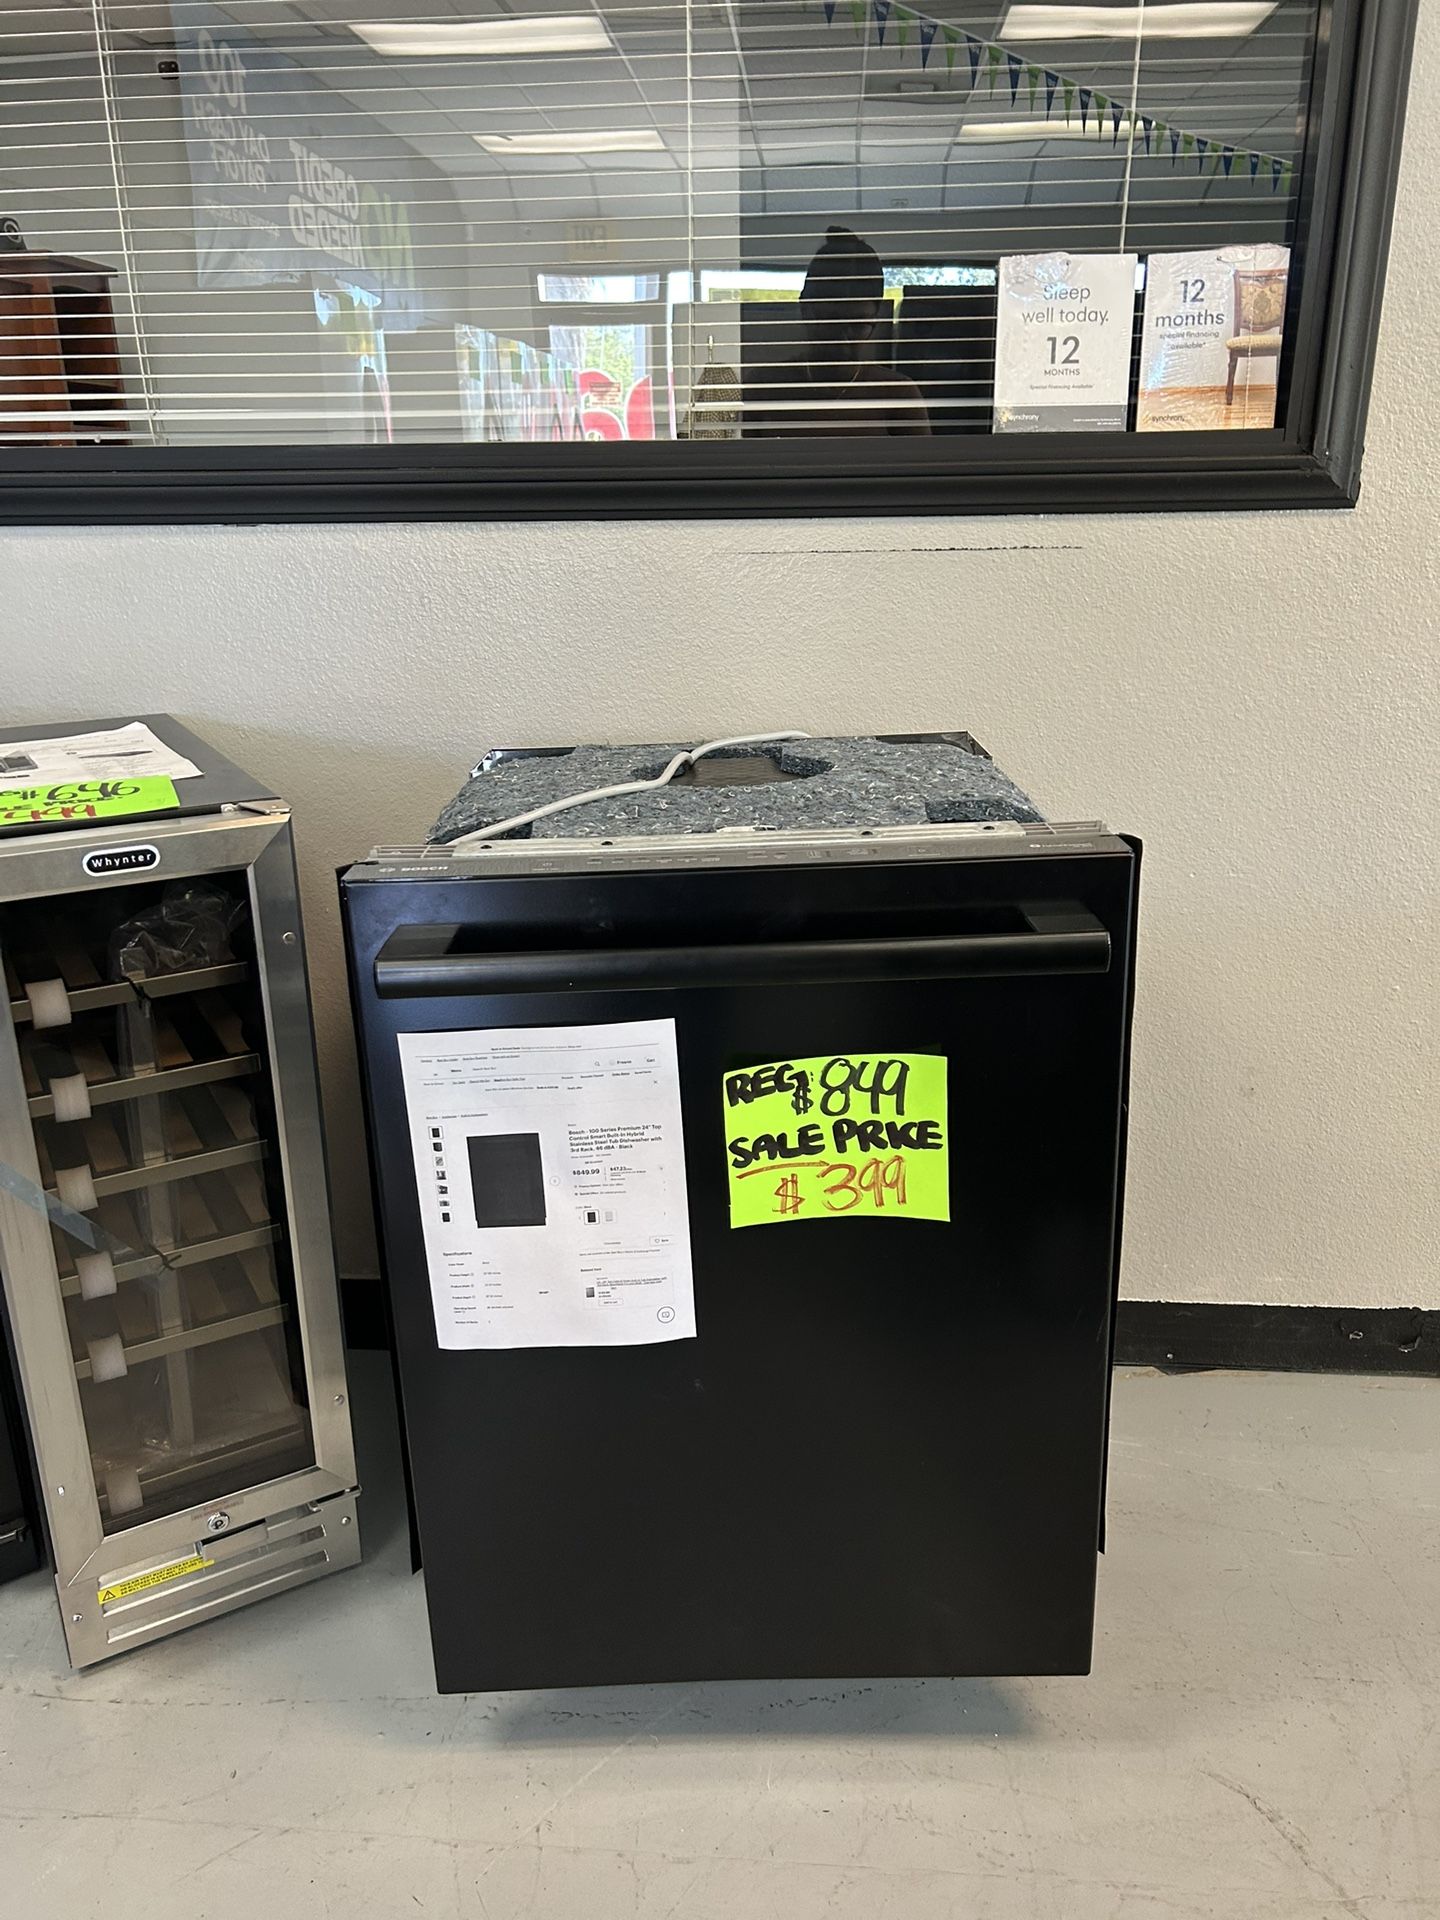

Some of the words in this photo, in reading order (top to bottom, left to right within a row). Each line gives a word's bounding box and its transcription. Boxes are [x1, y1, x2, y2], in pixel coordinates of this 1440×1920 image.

[1180, 279, 1205, 303] 12
[1022, 307, 1054, 323] well
[1059, 306, 1109, 326] today.
[1155, 309, 1225, 327] months
[1046, 335, 1080, 365] 12
[1044, 368, 1081, 376] MONTHS
[91, 852, 153, 868] Whynter
[728, 1123, 826, 1169] SALE
[832, 1118, 943, 1154] PRICE
